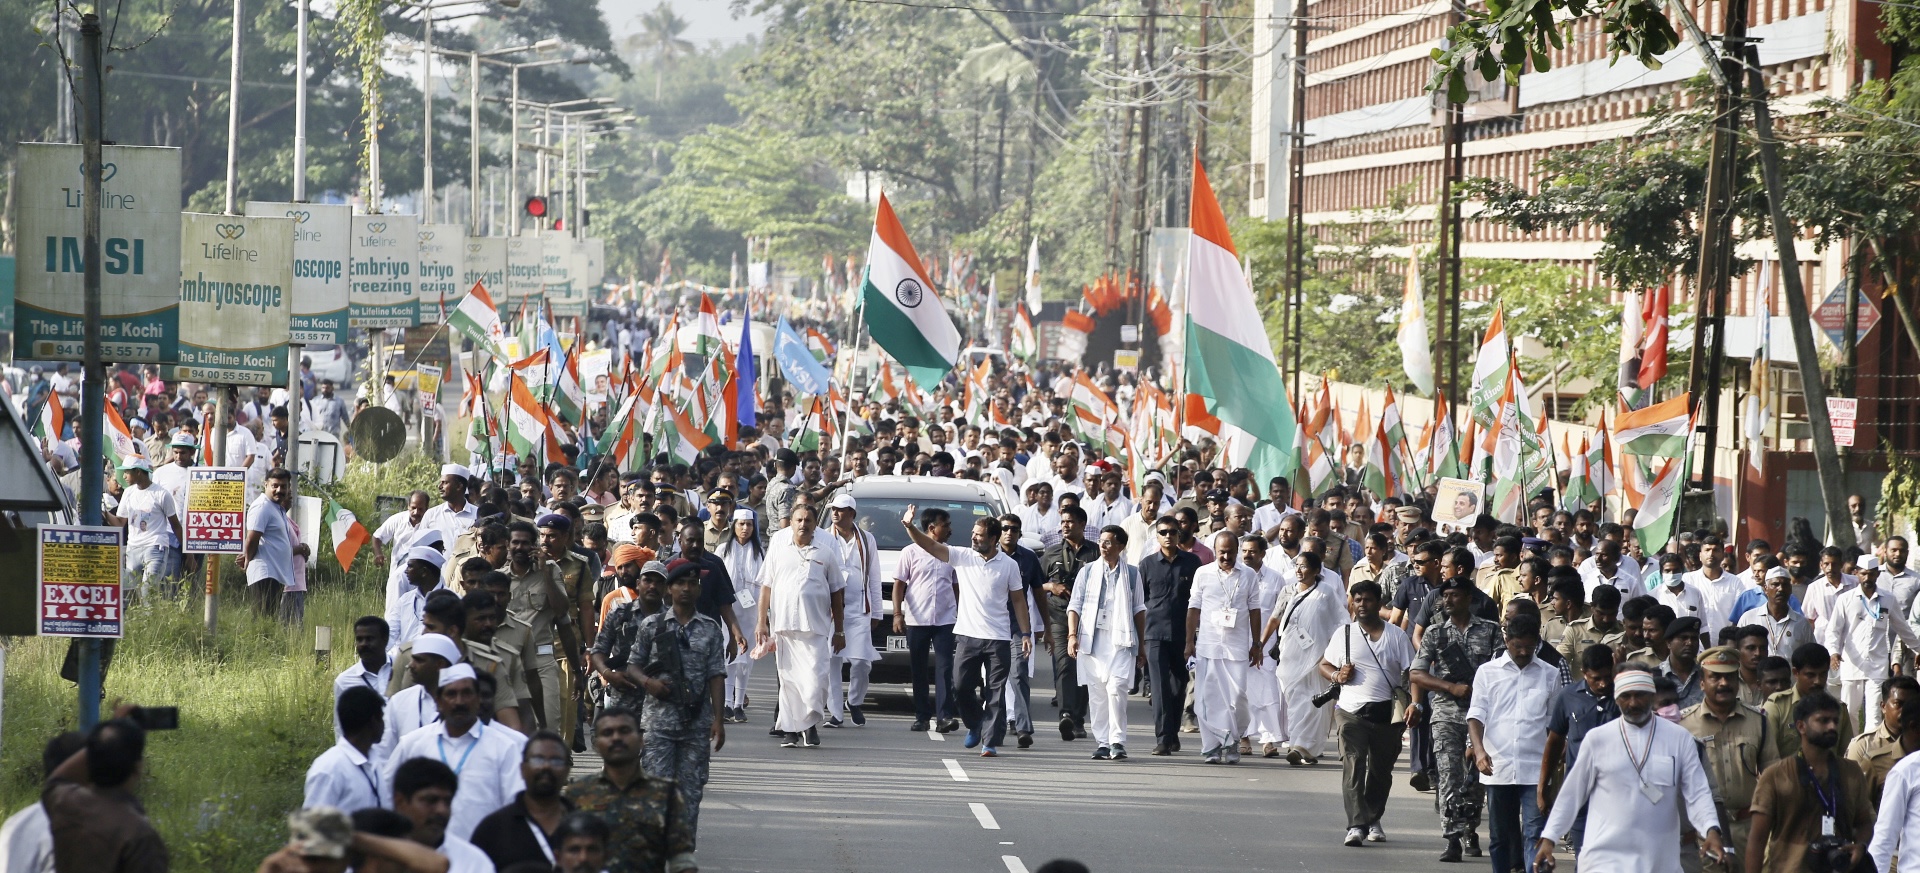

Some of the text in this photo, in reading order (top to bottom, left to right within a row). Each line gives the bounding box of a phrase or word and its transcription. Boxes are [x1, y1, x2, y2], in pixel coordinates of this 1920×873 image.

[61, 187, 135, 209] Liline
[293, 227, 321, 242] eline
[358, 236, 396, 247] Lifeline
[201, 242, 258, 262] Lifeline
[544, 255, 561, 263] ser
[294, 259, 342, 284] oscope
[420, 260, 454, 280] briyo
[507, 263, 541, 280] stocyst
[542, 265, 568, 279] ching
[464, 269, 504, 288] stocyst
[350, 279, 412, 295] reezing
[420, 280, 455, 295] ezing
[350, 306, 413, 316] he Lifeline Kochi
[30, 320, 163, 338] The Lifne Kochi
[311, 318, 338, 329] Kochi
[466, 325, 484, 343] Youth
[56, 345, 72, 355] 94
[77, 344, 84, 355] 0
[116, 346, 132, 356] 55
[136, 347, 152, 357] 77
[178, 350, 276, 367] he Lifeline Kochi
[222, 372, 235, 380] 55
[238, 373, 251, 381] 55
[253, 374, 266, 382] 77
[787, 359, 819, 393] KSU
[1828, 399, 1855, 409] TUITION
[191, 471, 216, 480] I.T.I
[188, 512, 242, 528] EXCEL
[43, 531, 80, 543] I.T.I
[188, 528, 242, 540] I.T.I
[44, 584, 118, 605] EXCEL
[44, 604, 118, 620] I.T.I
